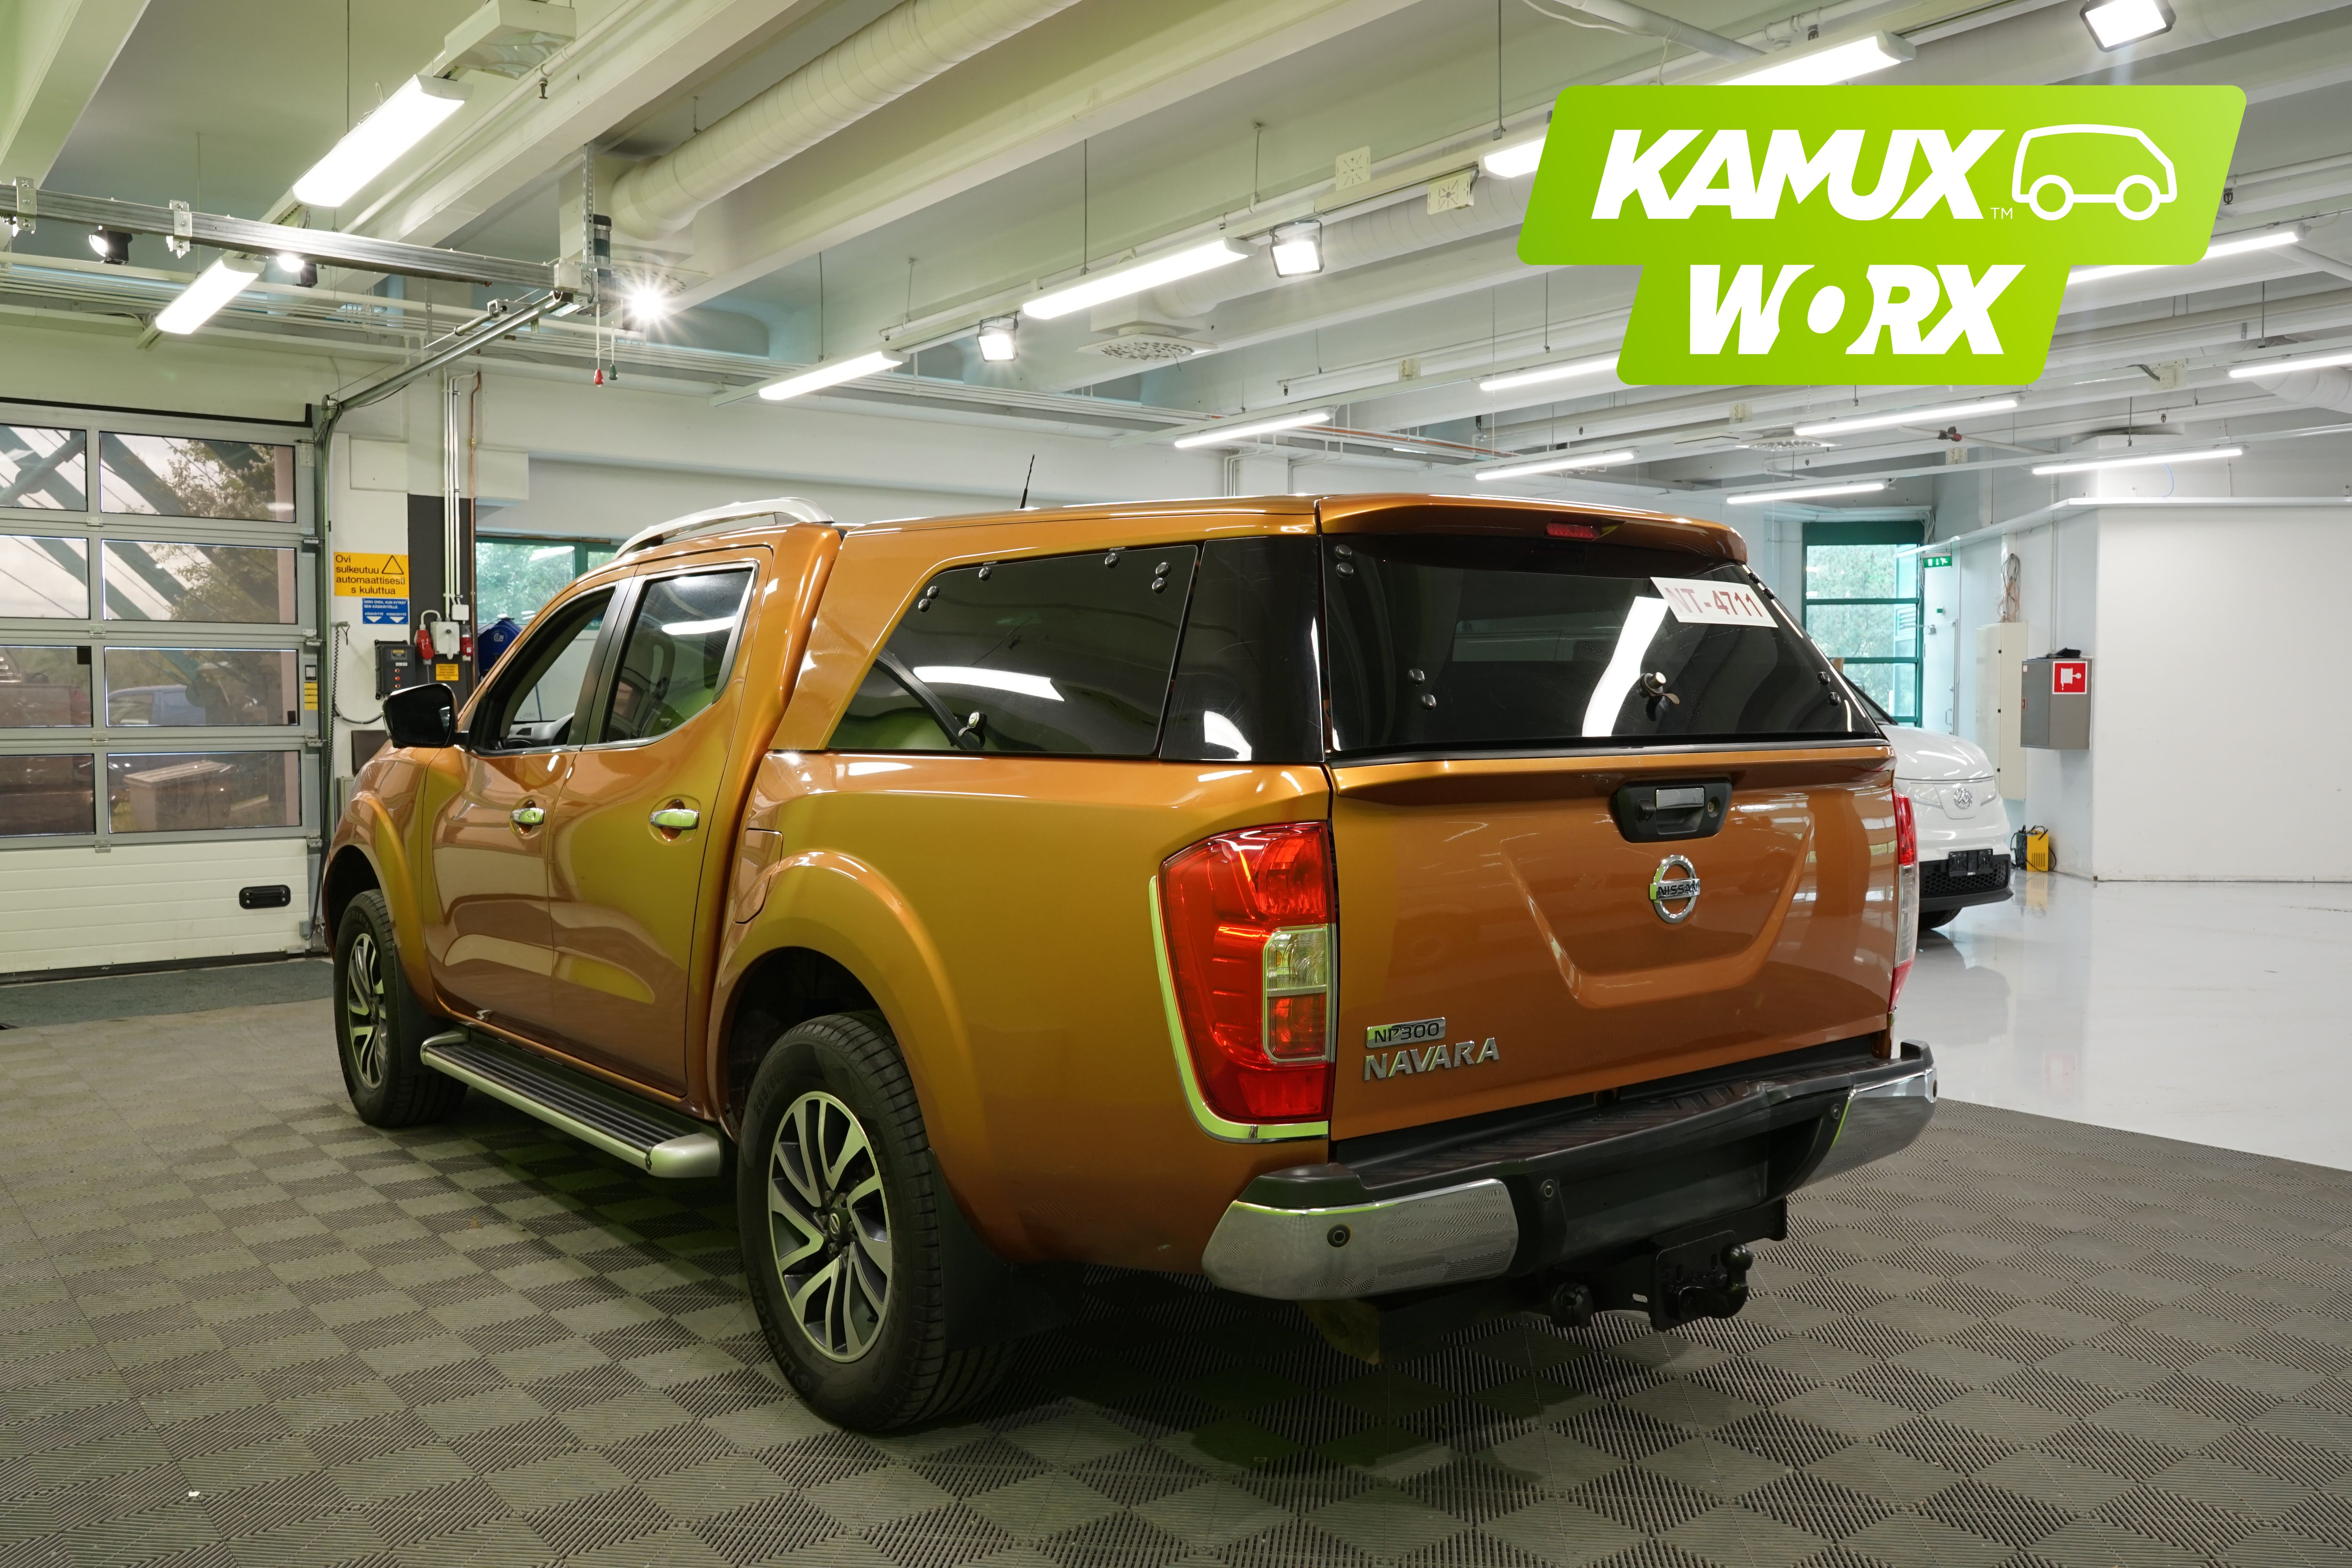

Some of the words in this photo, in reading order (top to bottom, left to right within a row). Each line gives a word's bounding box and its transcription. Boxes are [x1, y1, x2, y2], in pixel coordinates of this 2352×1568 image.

[336, 555, 351, 563] Ovi
[336, 565, 379, 573] sulkeutuu
[336, 576, 405, 584] automaattisesti
[359, 586, 396, 594] kuluttua
[1657, 880, 1698, 896] NISSAN
[1375, 1022, 1439, 1044] NP300
[1364, 1037, 1500, 1081] NAVARA
